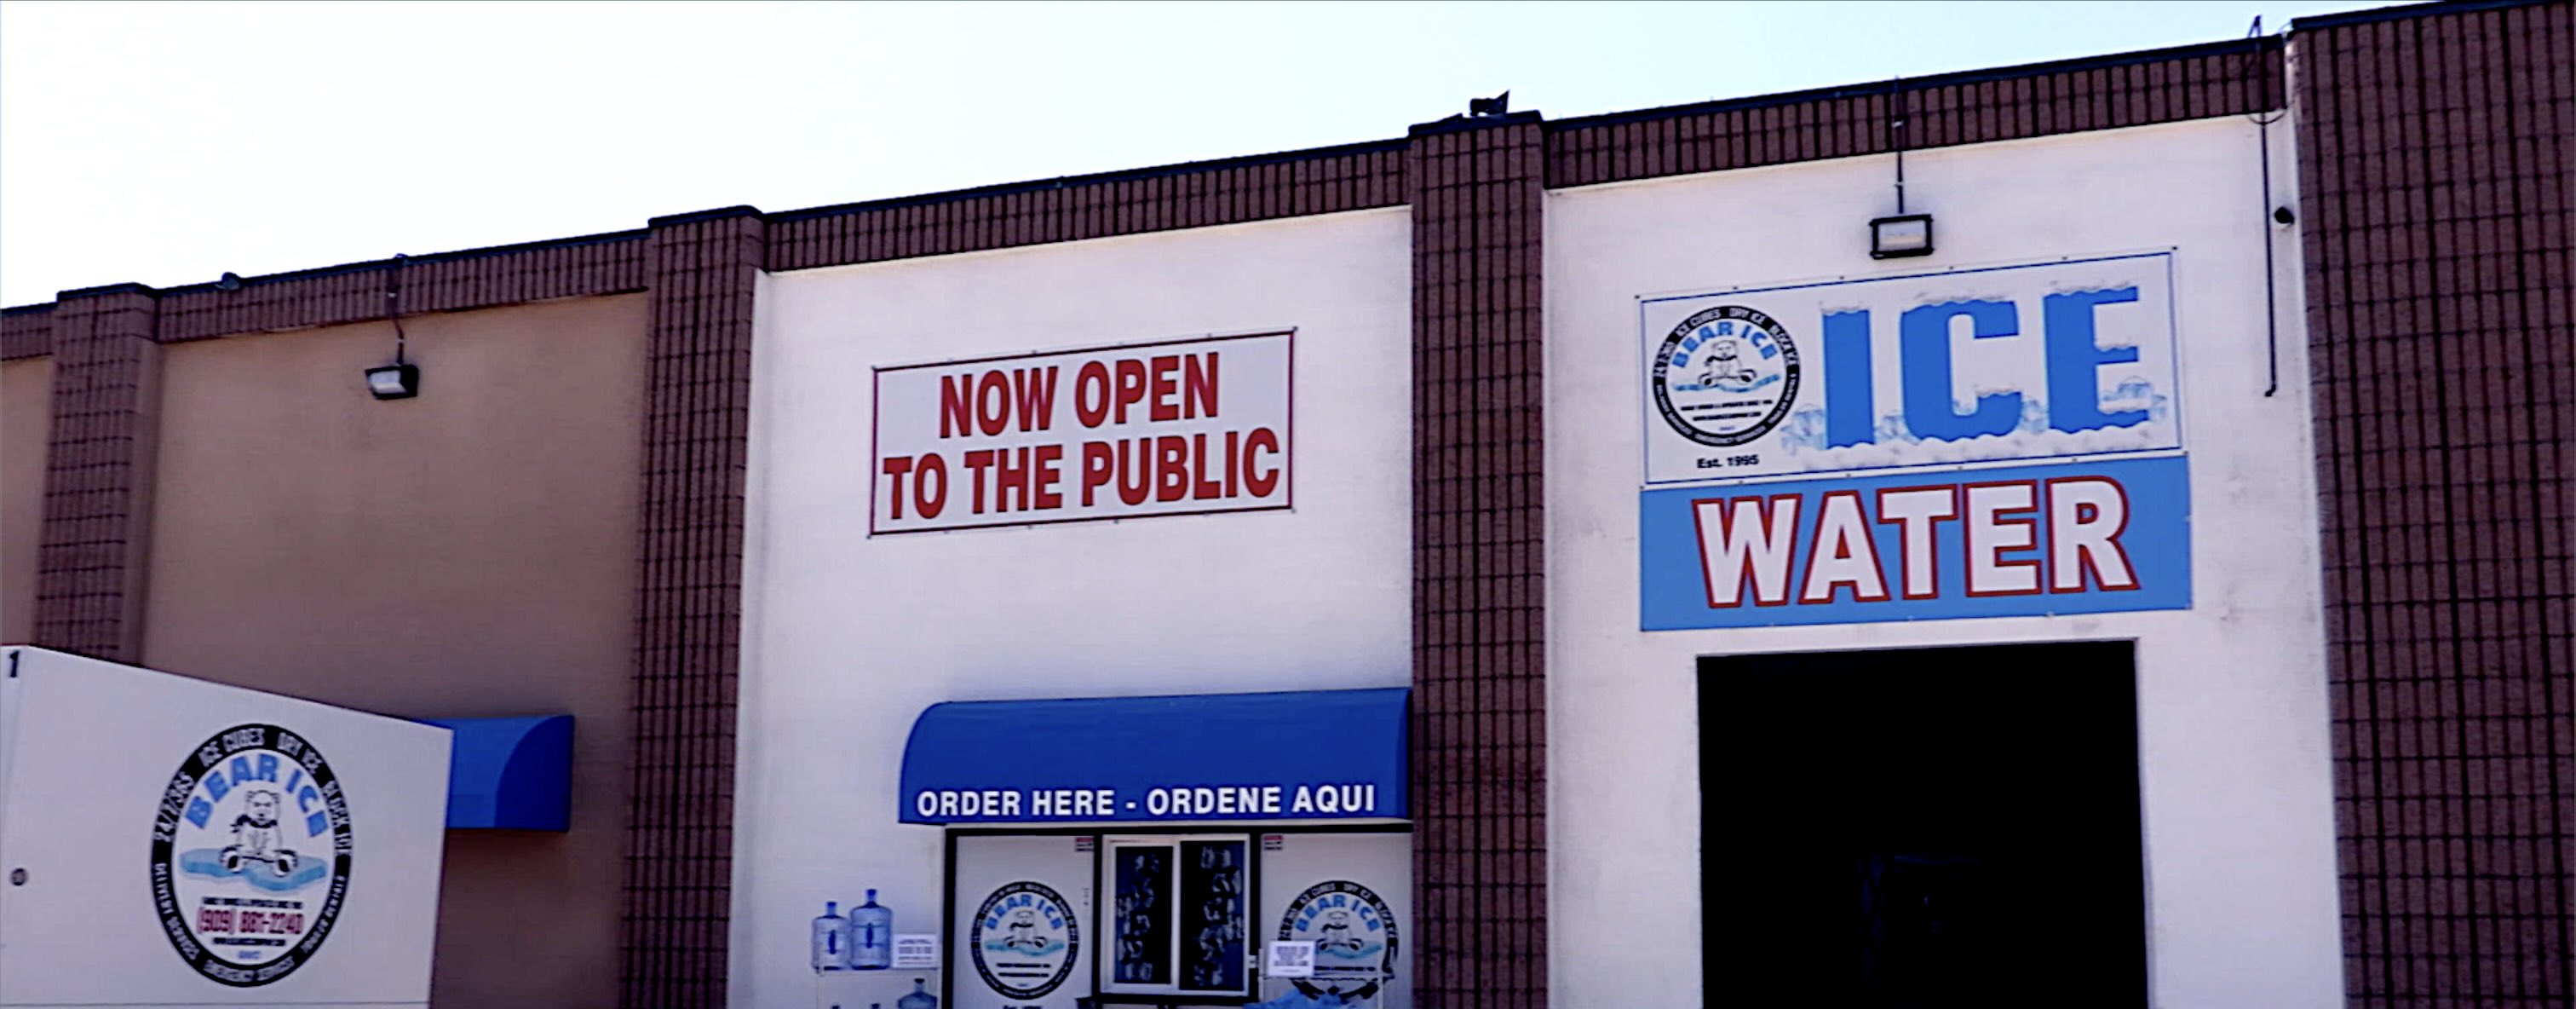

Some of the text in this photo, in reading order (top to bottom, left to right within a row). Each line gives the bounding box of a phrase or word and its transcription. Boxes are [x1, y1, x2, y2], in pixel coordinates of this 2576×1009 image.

[1672, 321, 1778, 367] BEAR ICE
[1822, 285, 2149, 450] ICE
[940, 351, 1219, 438] NOW OPEN
[883, 427, 1279, 519] TO THE PUBLIC
[1692, 475, 2141, 608] WATER
[9, 649, 21, 678] 1
[197, 739, 223, 768] ICE
[221, 727, 266, 753] CUBES
[301, 747, 324, 775] ICE
[184, 753, 329, 838] BEAR ICE
[917, 791, 1021, 817] ORDER
[1032, 789, 1115, 816] HERE
[1147, 786, 1281, 816] ORDENE
[1291, 784, 1375, 812] AQUI
[986, 894, 1032, 930] BEAR
[1036, 899, 1064, 930] ICE
[1295, 894, 1346, 932] BEAR
[1350, 899, 1381, 931] ICE
